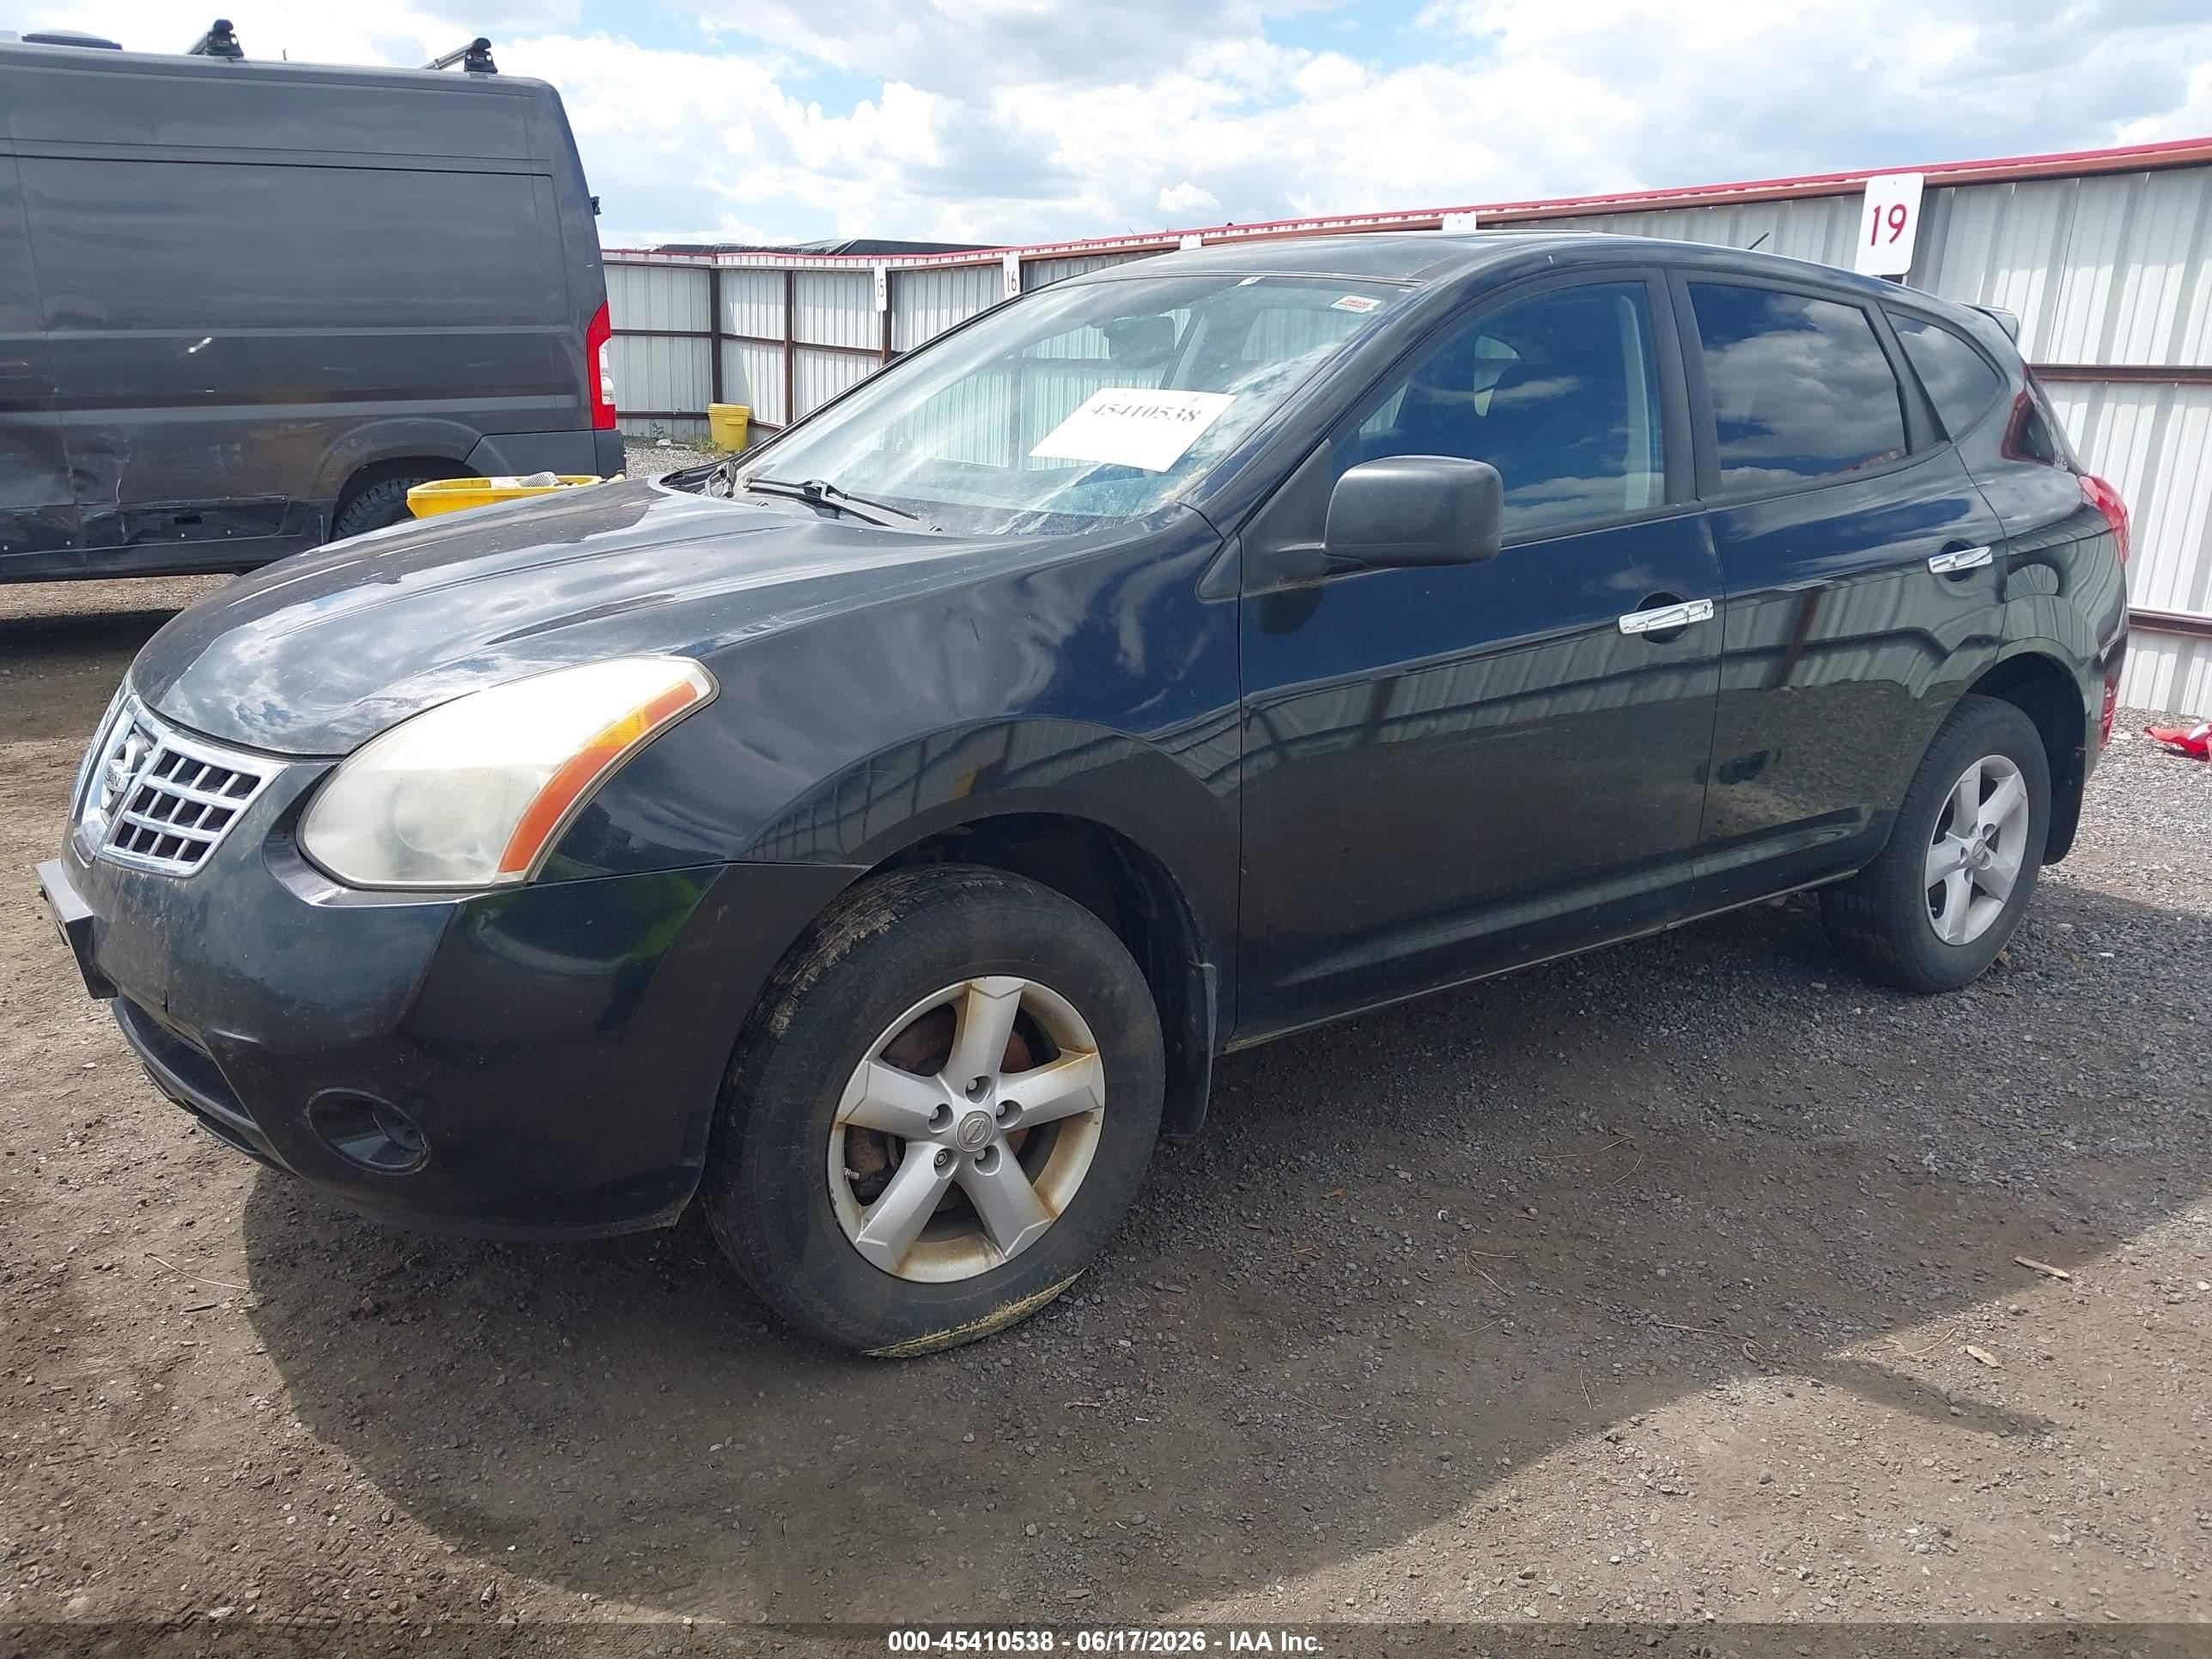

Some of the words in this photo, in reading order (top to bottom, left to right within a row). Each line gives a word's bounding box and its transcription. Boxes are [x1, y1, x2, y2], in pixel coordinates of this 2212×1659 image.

[1869, 204, 1908, 246] 19
[876, 277, 884, 299] 15
[1006, 270, 1018, 293] 16
